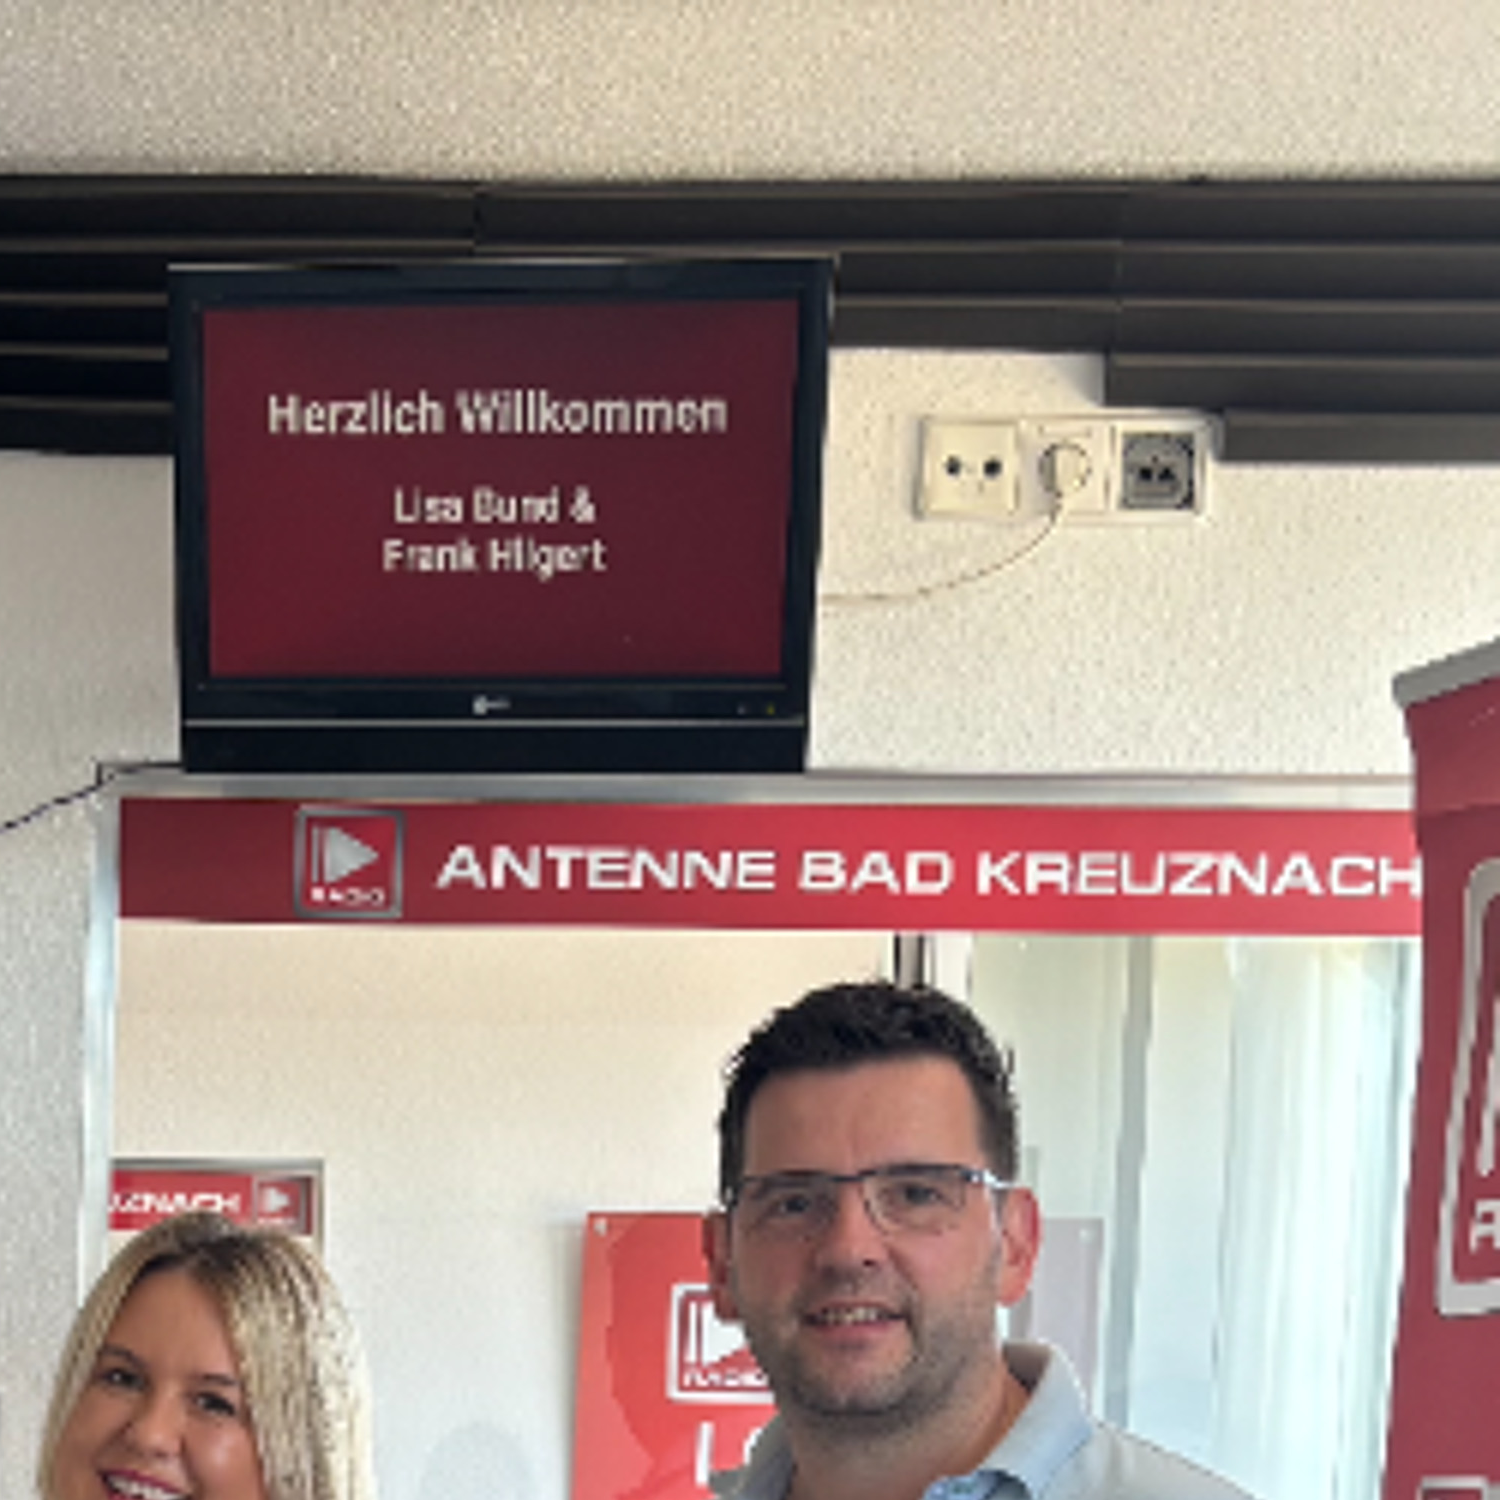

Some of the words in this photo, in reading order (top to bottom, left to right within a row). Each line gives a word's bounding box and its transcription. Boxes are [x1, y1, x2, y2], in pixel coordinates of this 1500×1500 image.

[268, 390, 445, 434] Herzlich
[456, 388, 728, 434] Willkommen
[394, 487, 463, 524] Lisa
[473, 487, 559, 524] Bund
[570, 487, 597, 524] &
[383, 538, 478, 572] Frank
[488, 536, 607, 581] Hilgert
[435, 844, 777, 891] ANTENNE
[798, 851, 954, 893] BAD
[977, 851, 1422, 896] KREUZNACH
